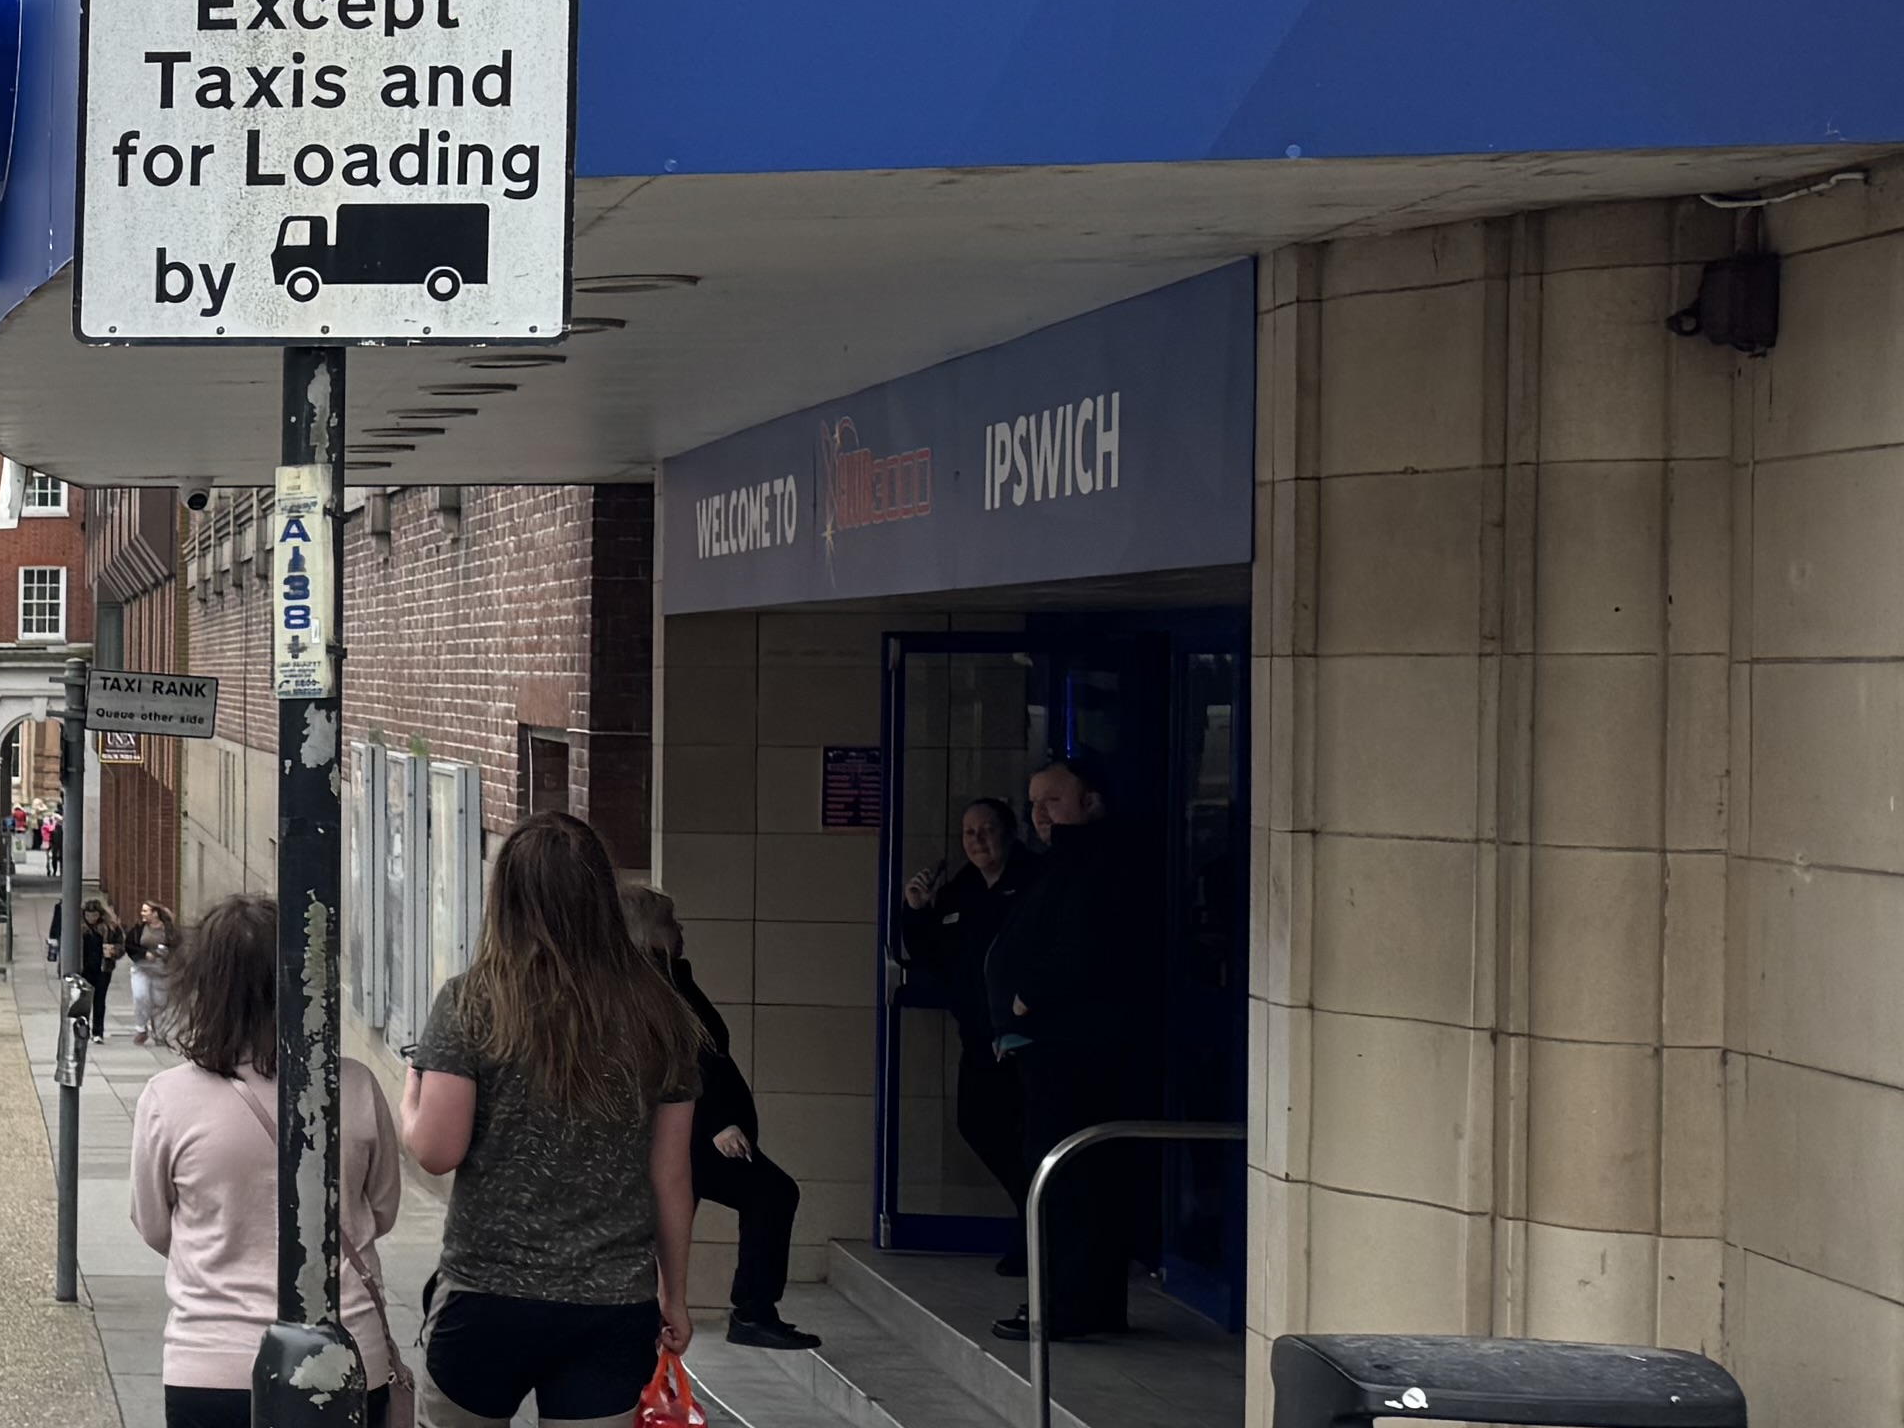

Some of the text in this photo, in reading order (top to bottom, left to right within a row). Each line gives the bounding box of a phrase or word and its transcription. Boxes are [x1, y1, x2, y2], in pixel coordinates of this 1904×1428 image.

[144, 50, 512, 109] Taxis and
[112, 129, 540, 199] for Loading
[156, 247, 236, 317] by
[985, 390, 1120, 512] IPSWICH
[695, 482, 771, 559] WELCOME
[773, 474, 798, 546] TO
[96, 708, 204, 725] Queue other side
[100, 677, 207, 698] TAXI RANK
